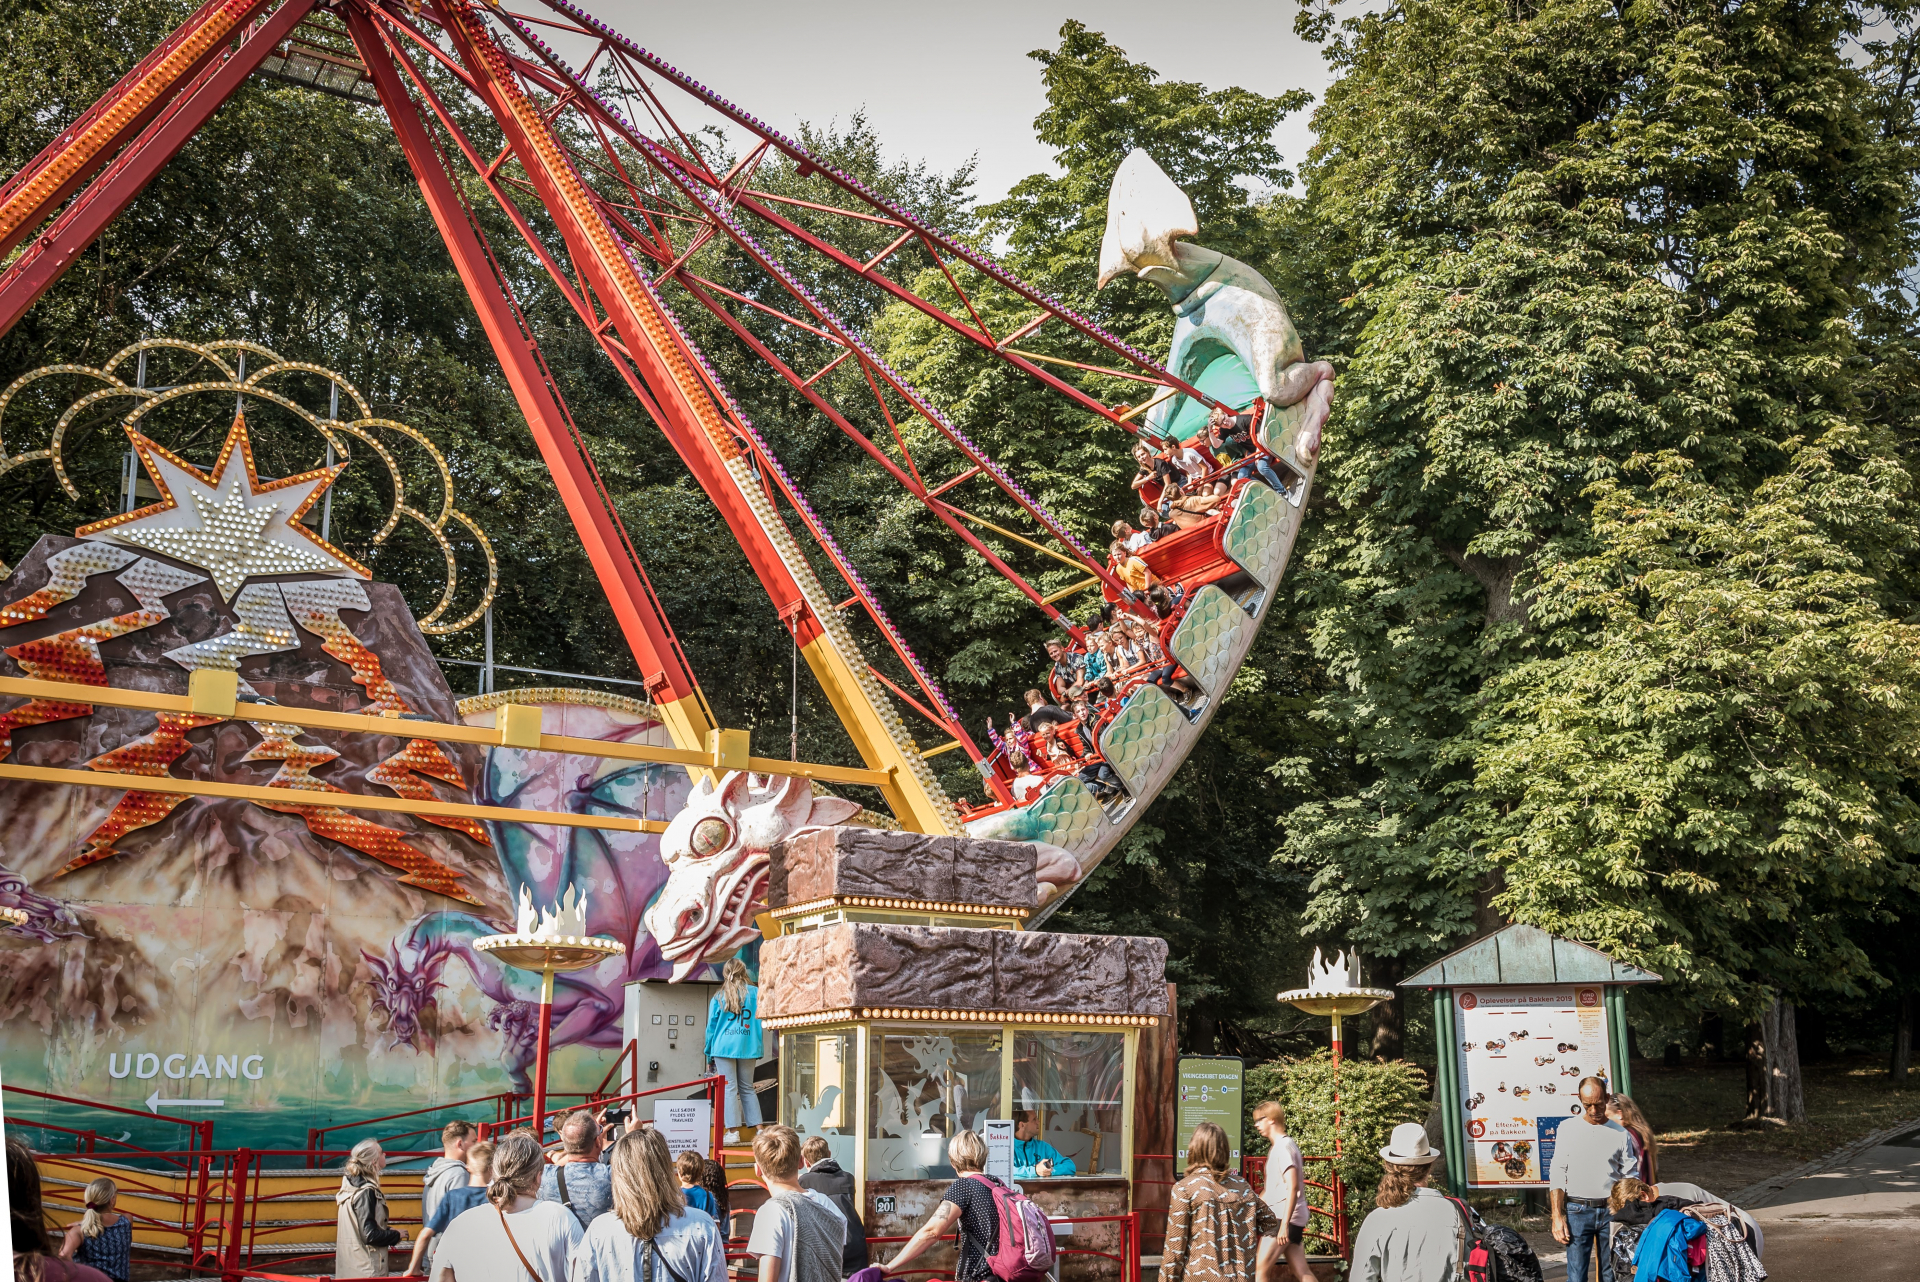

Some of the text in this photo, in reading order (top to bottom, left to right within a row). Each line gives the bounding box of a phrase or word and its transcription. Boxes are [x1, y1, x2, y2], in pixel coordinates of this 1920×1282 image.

[725, 1027, 750, 1036] Bakken
[108, 1052, 264, 1080] UDGANG
[878, 1202, 894, 1212] 201
